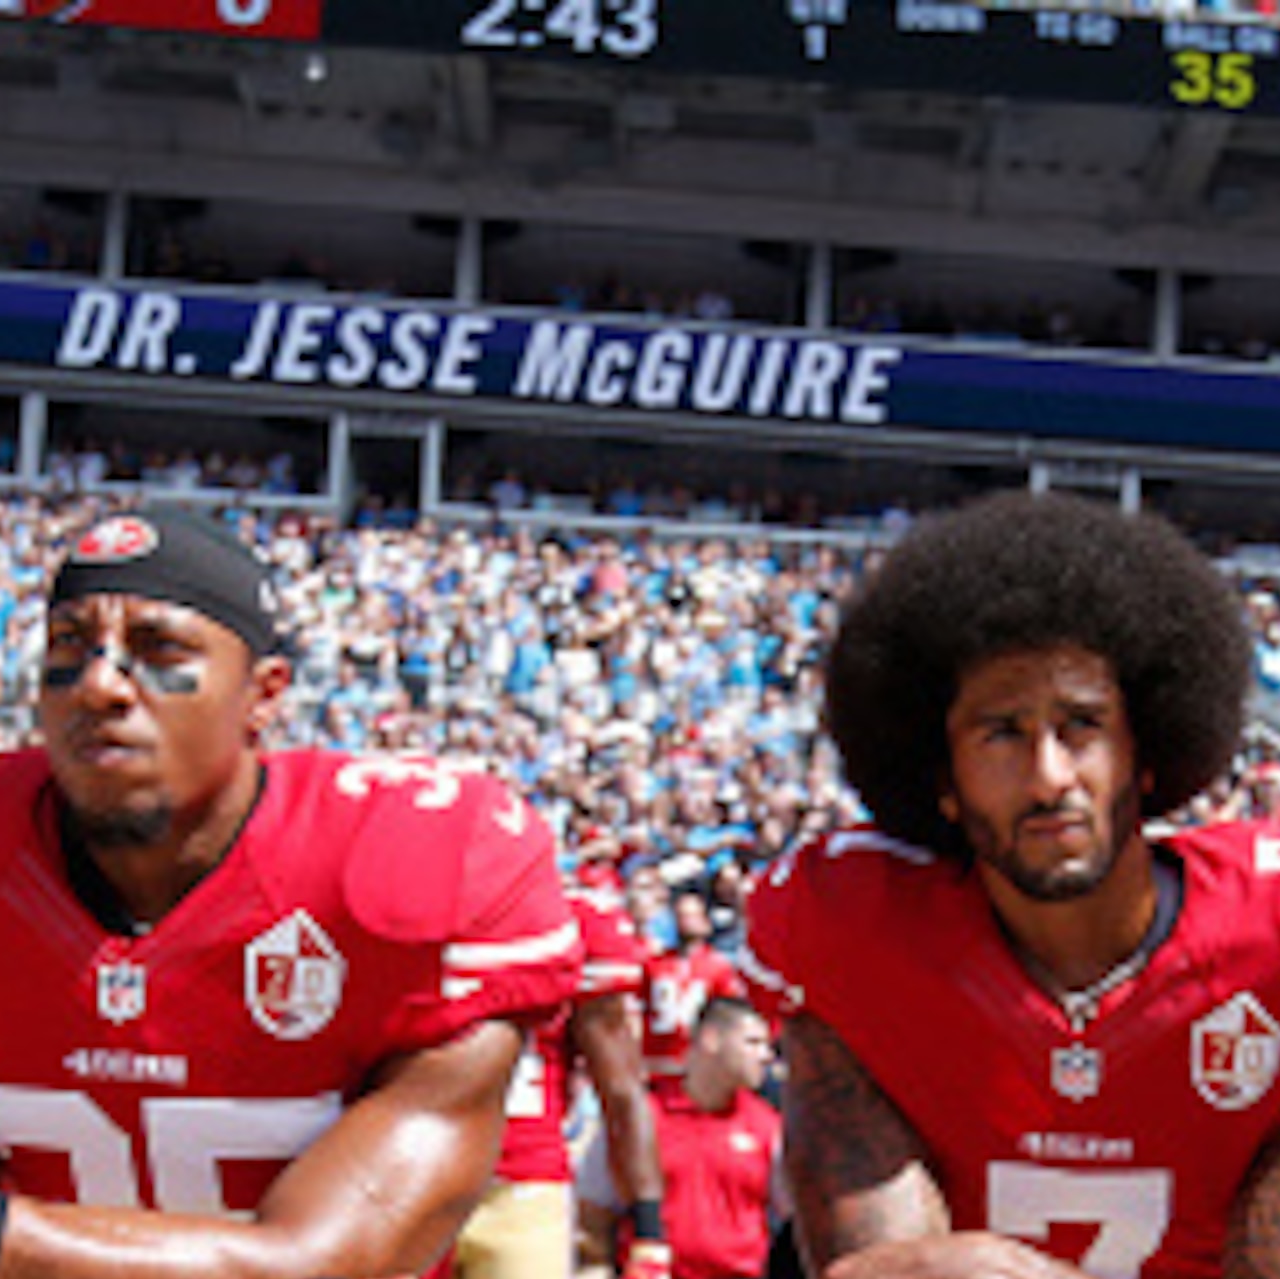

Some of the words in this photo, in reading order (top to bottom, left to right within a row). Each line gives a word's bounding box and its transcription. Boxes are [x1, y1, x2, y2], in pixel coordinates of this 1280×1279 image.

[1170, 50, 1256, 109] 35
[55, 288, 197, 374] DR.
[228, 300, 493, 395] JESSE
[513, 319, 903, 425] McGUIRE
